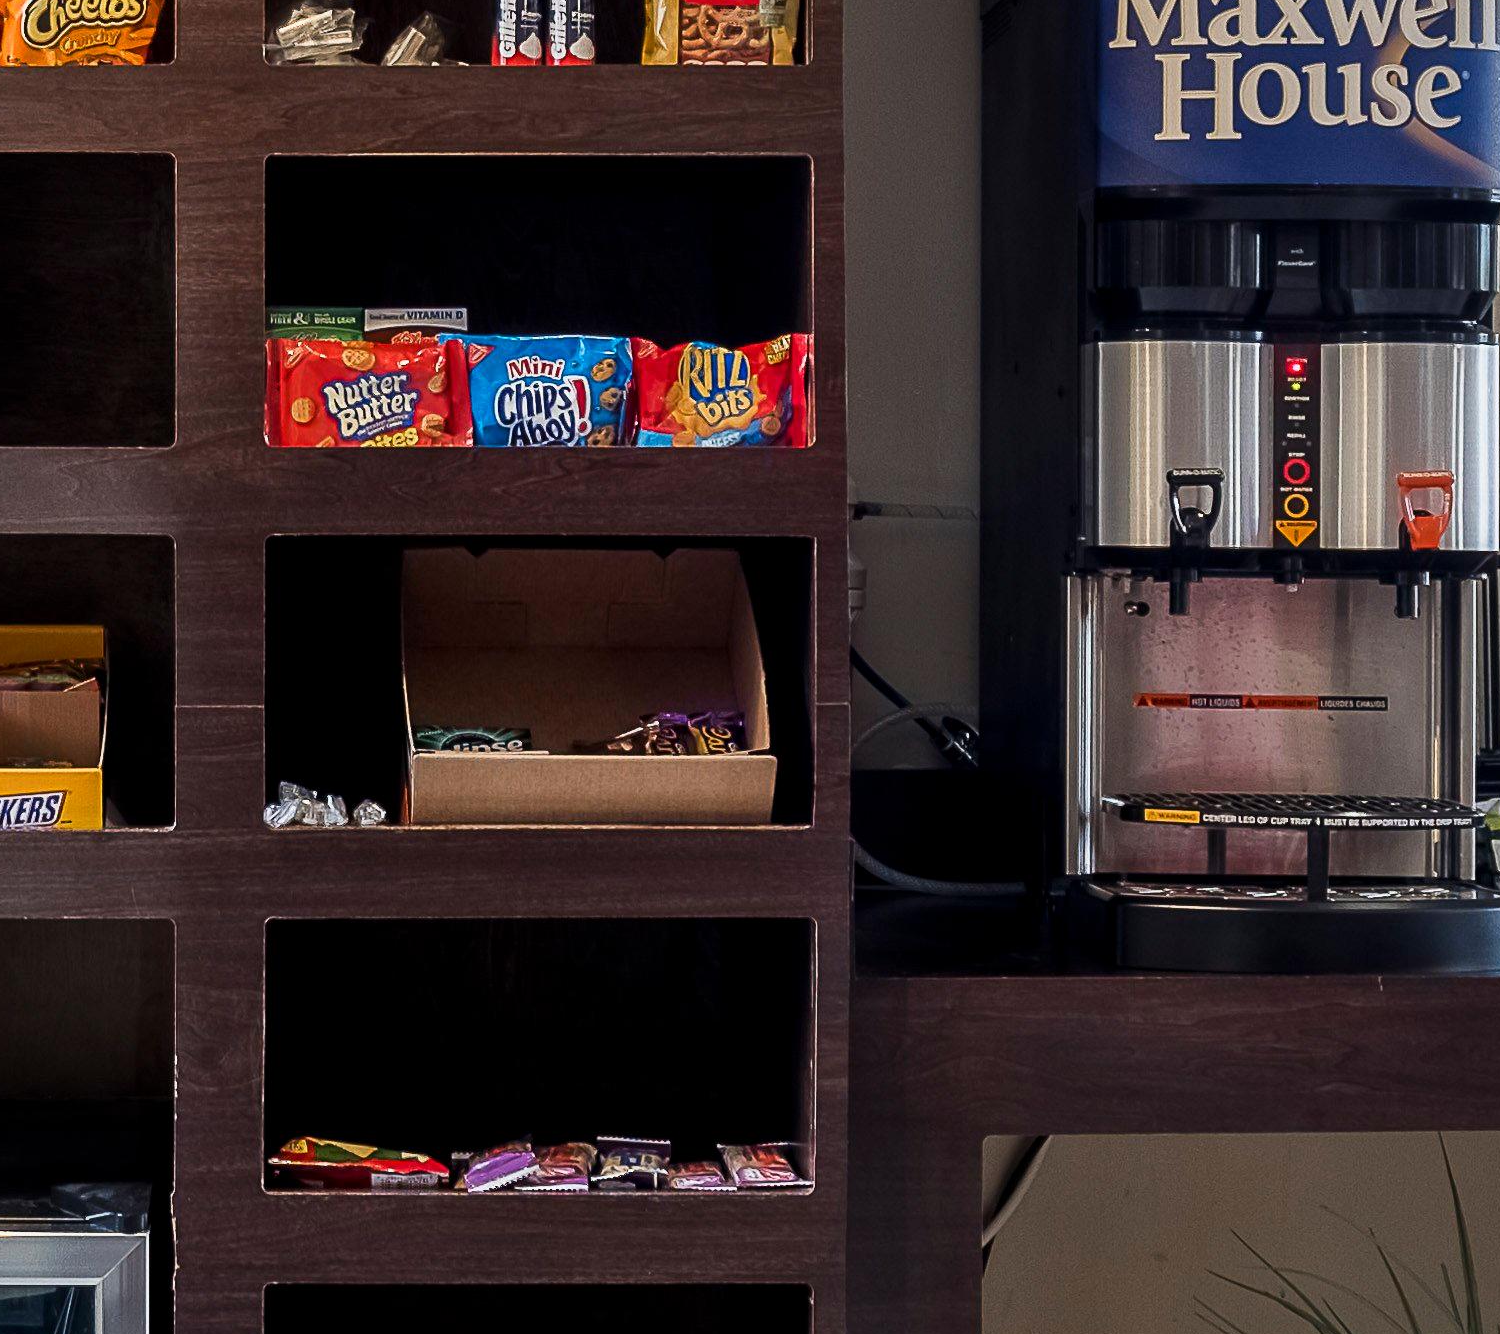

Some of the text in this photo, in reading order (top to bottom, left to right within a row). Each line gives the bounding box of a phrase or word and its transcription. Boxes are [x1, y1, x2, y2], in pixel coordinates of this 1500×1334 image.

[1153, 51, 1463, 142] House
[406, 310, 464, 320] VITAMIN D
[508, 358, 563, 379] Mini
[682, 347, 748, 398] RITZ
[324, 375, 407, 414] Nutter
[498, 382, 573, 426] Chips
[698, 389, 752, 425] bits
[337, 392, 417, 437] Butter
[1191, 698, 1207, 707] HOT
[1209, 698, 1241, 708] LIQUIDS
[1320, 700, 1354, 708] LIQUIDES
[1203, 814, 1236, 824] CENTER
